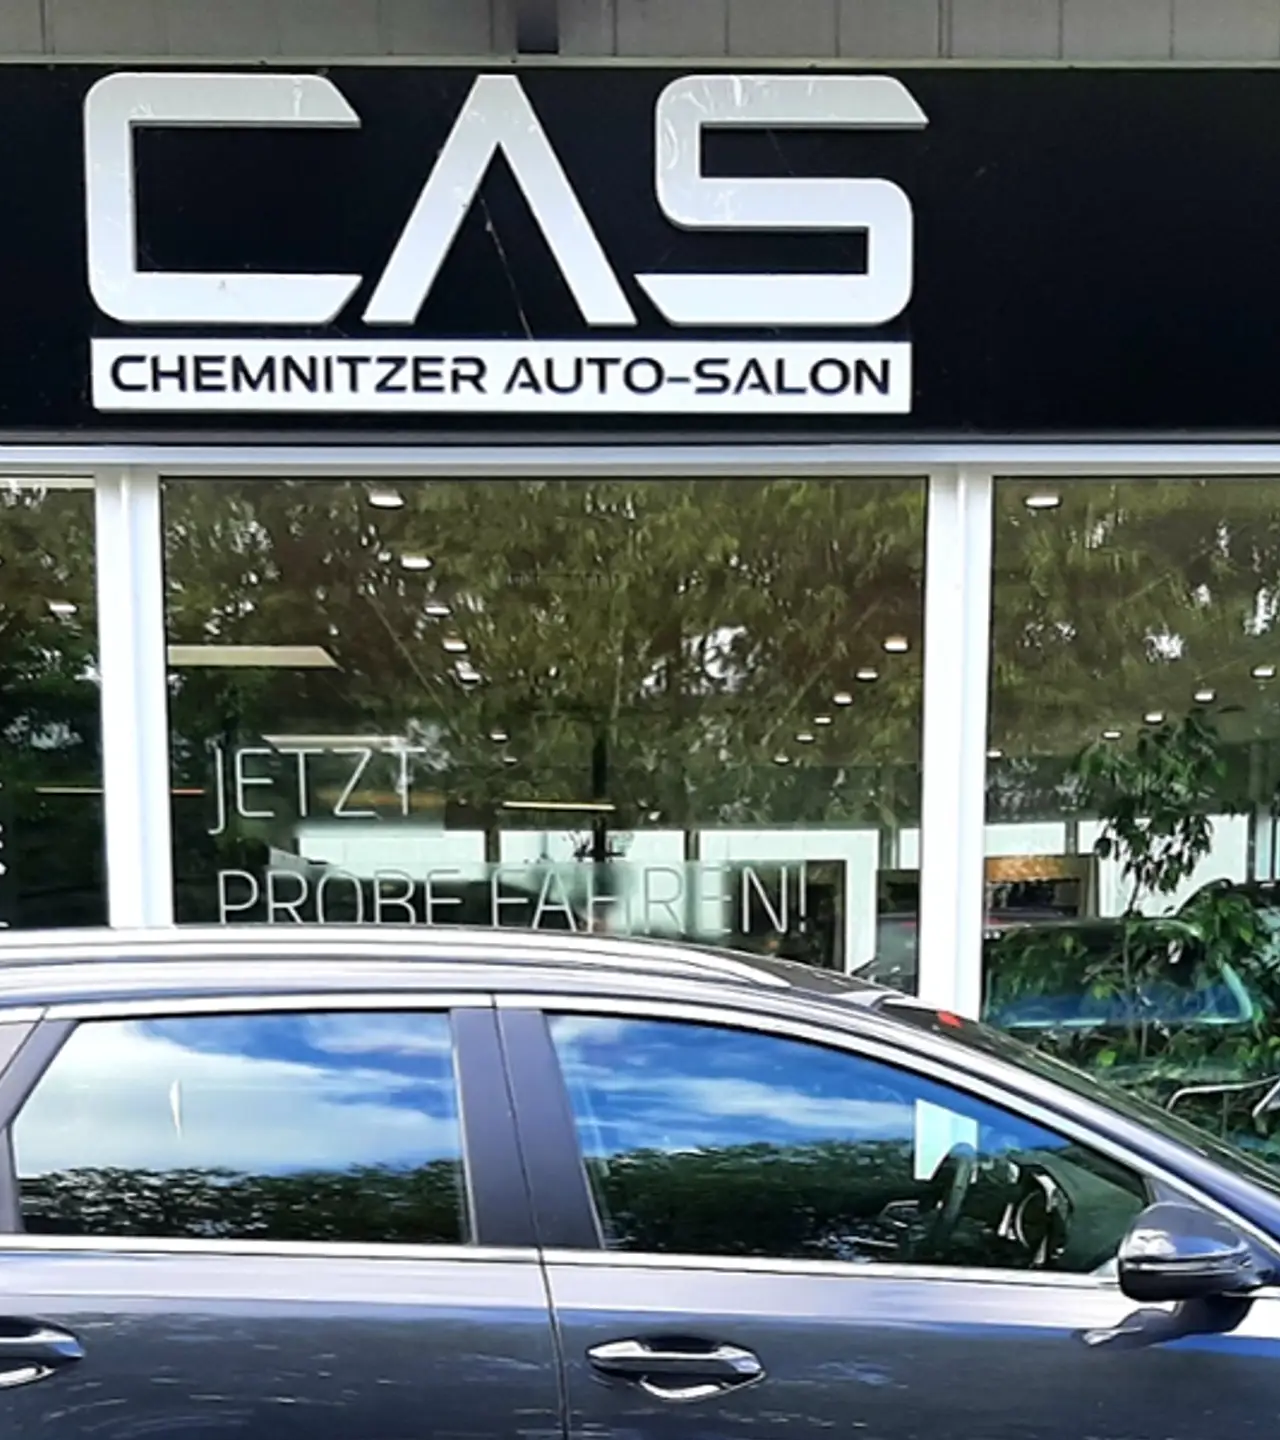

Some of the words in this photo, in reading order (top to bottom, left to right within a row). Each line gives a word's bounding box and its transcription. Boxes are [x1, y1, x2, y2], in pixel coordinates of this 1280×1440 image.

[83, 72, 929, 327] CAS
[110, 353, 488, 395] CHEMNITZER
[503, 355, 891, 397] AUTO-SALON
[209, 746, 426, 835] JETZT
